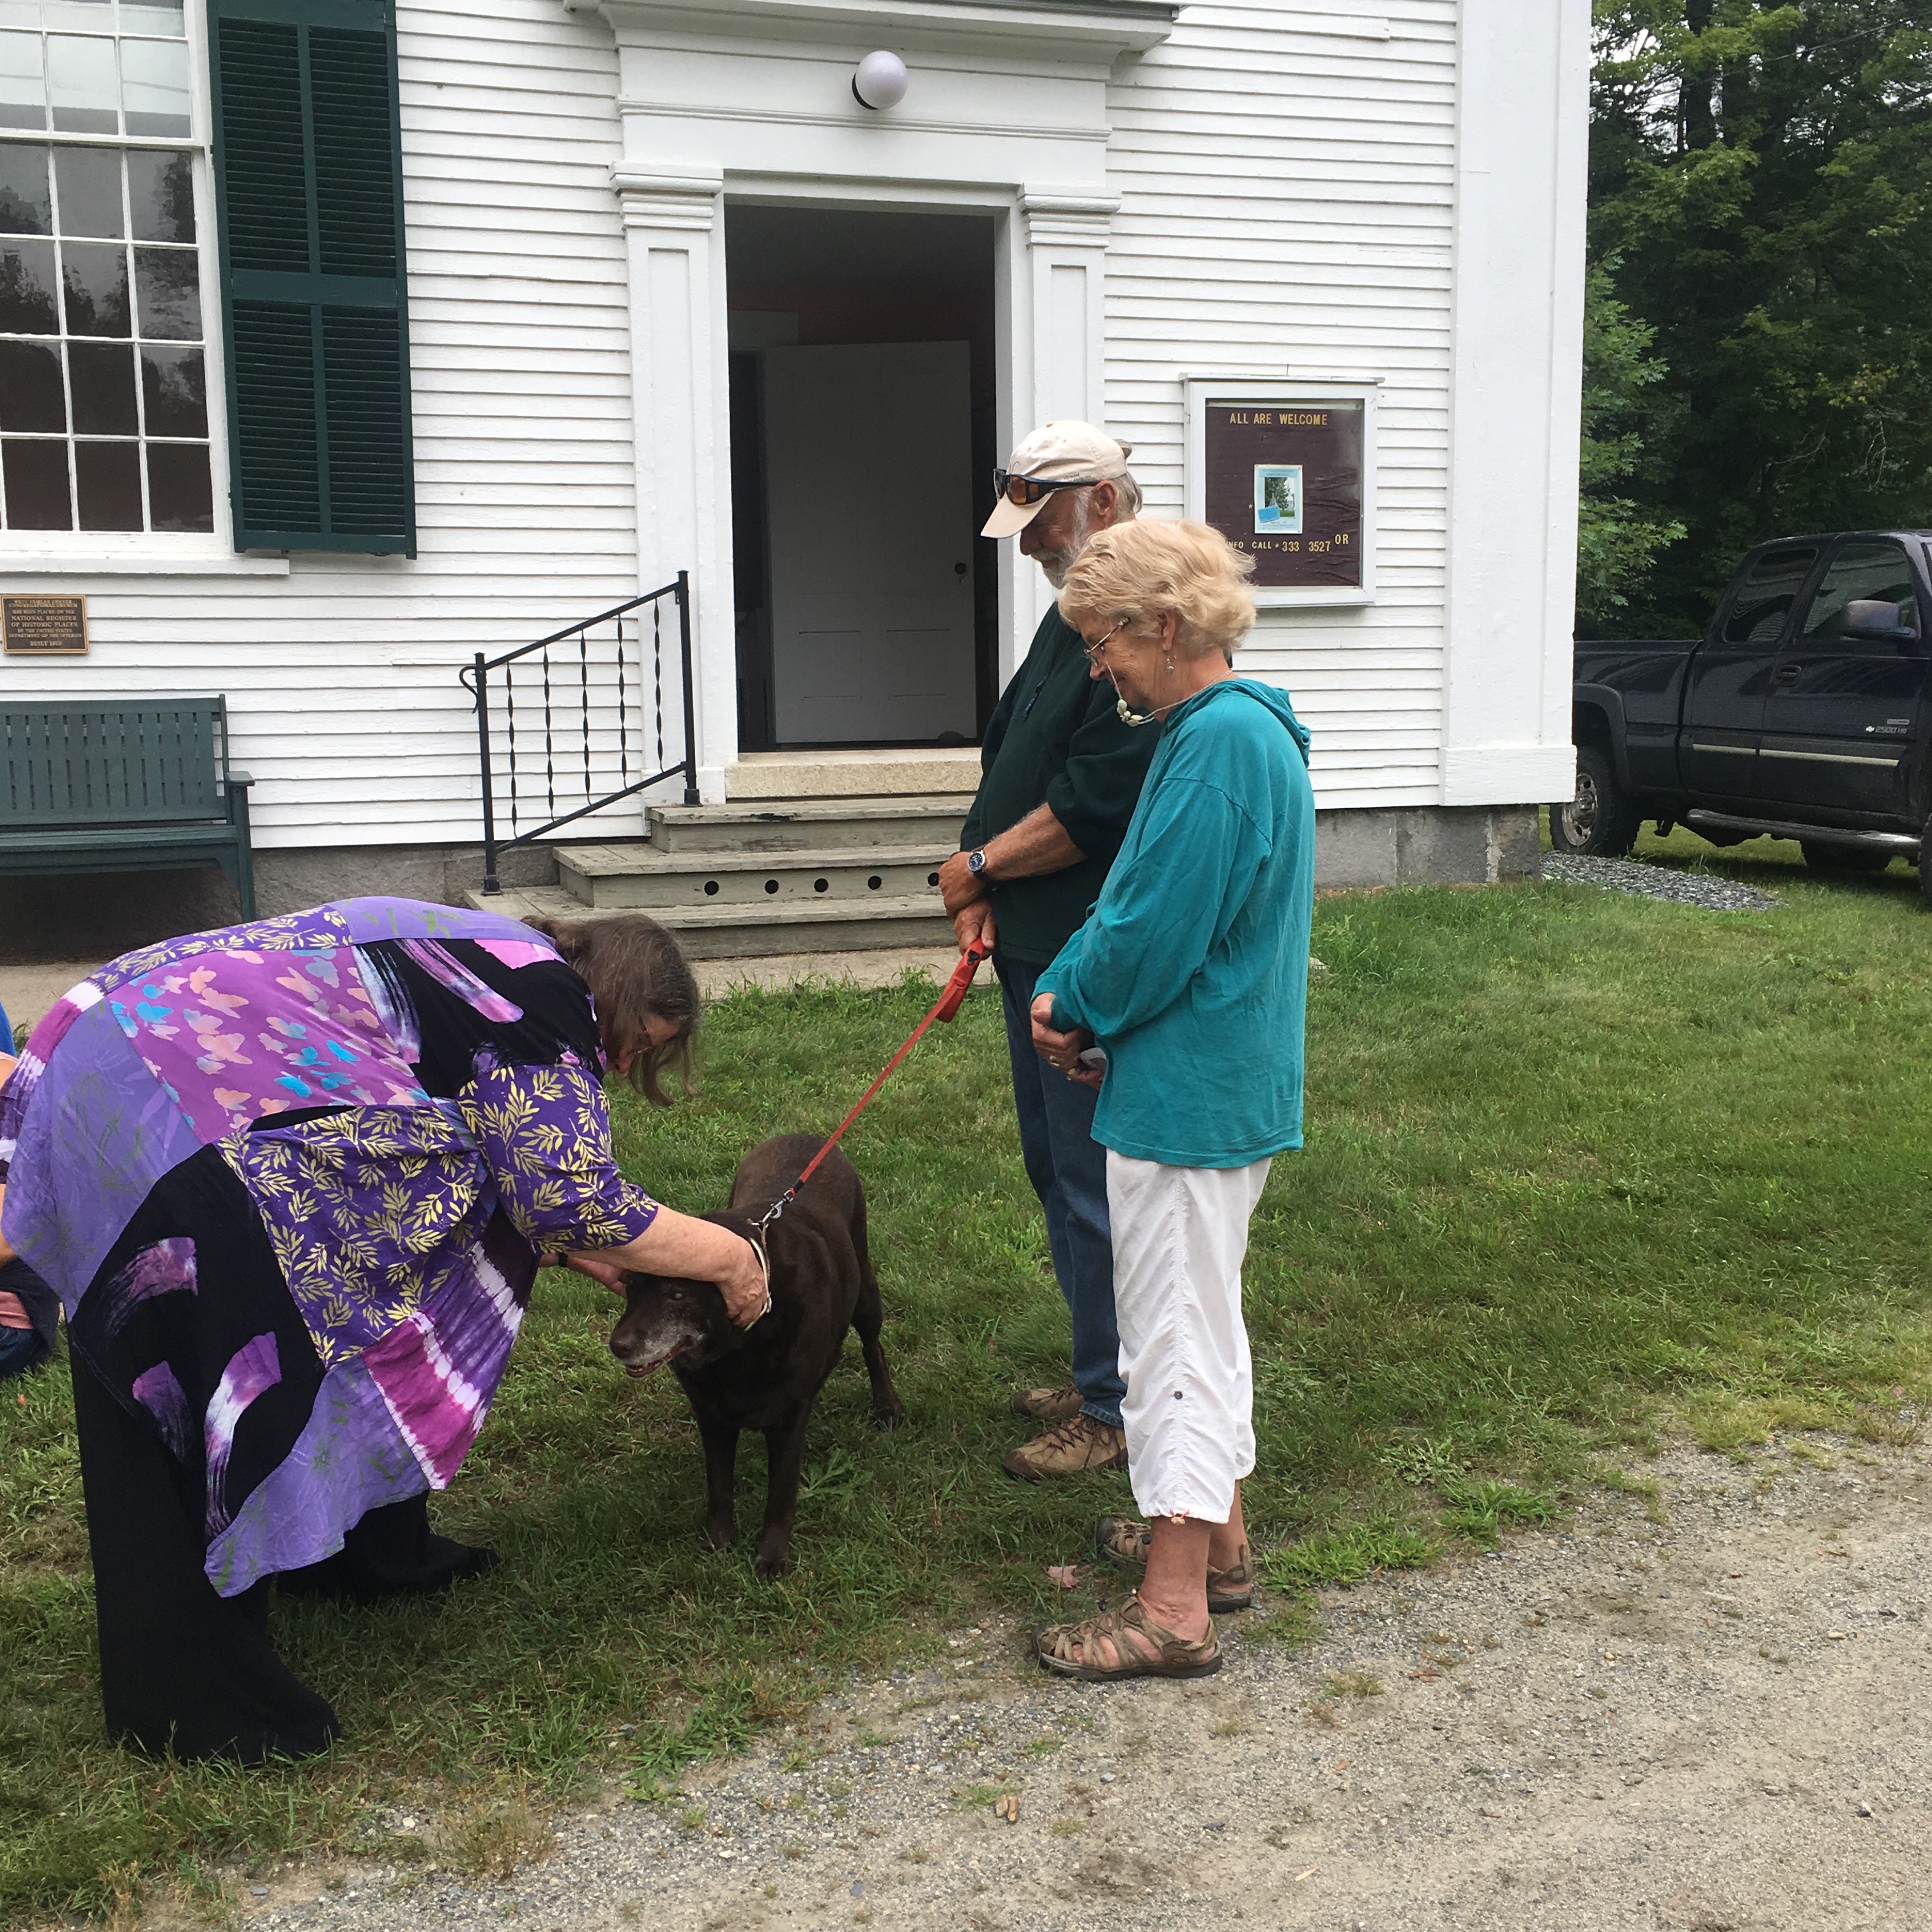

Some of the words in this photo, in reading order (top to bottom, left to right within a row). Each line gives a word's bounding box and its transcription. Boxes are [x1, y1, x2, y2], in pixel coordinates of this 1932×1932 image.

[1230, 413, 1249, 424] ALL
[1253, 413, 1272, 424] ARE
[1279, 413, 1328, 425] WELCOME
[1252, 540, 1271, 549] CALL
[1282, 540, 1300, 552] 333
[1308, 540, 1331, 552] 3527
[1335, 533, 1349, 545] OR
